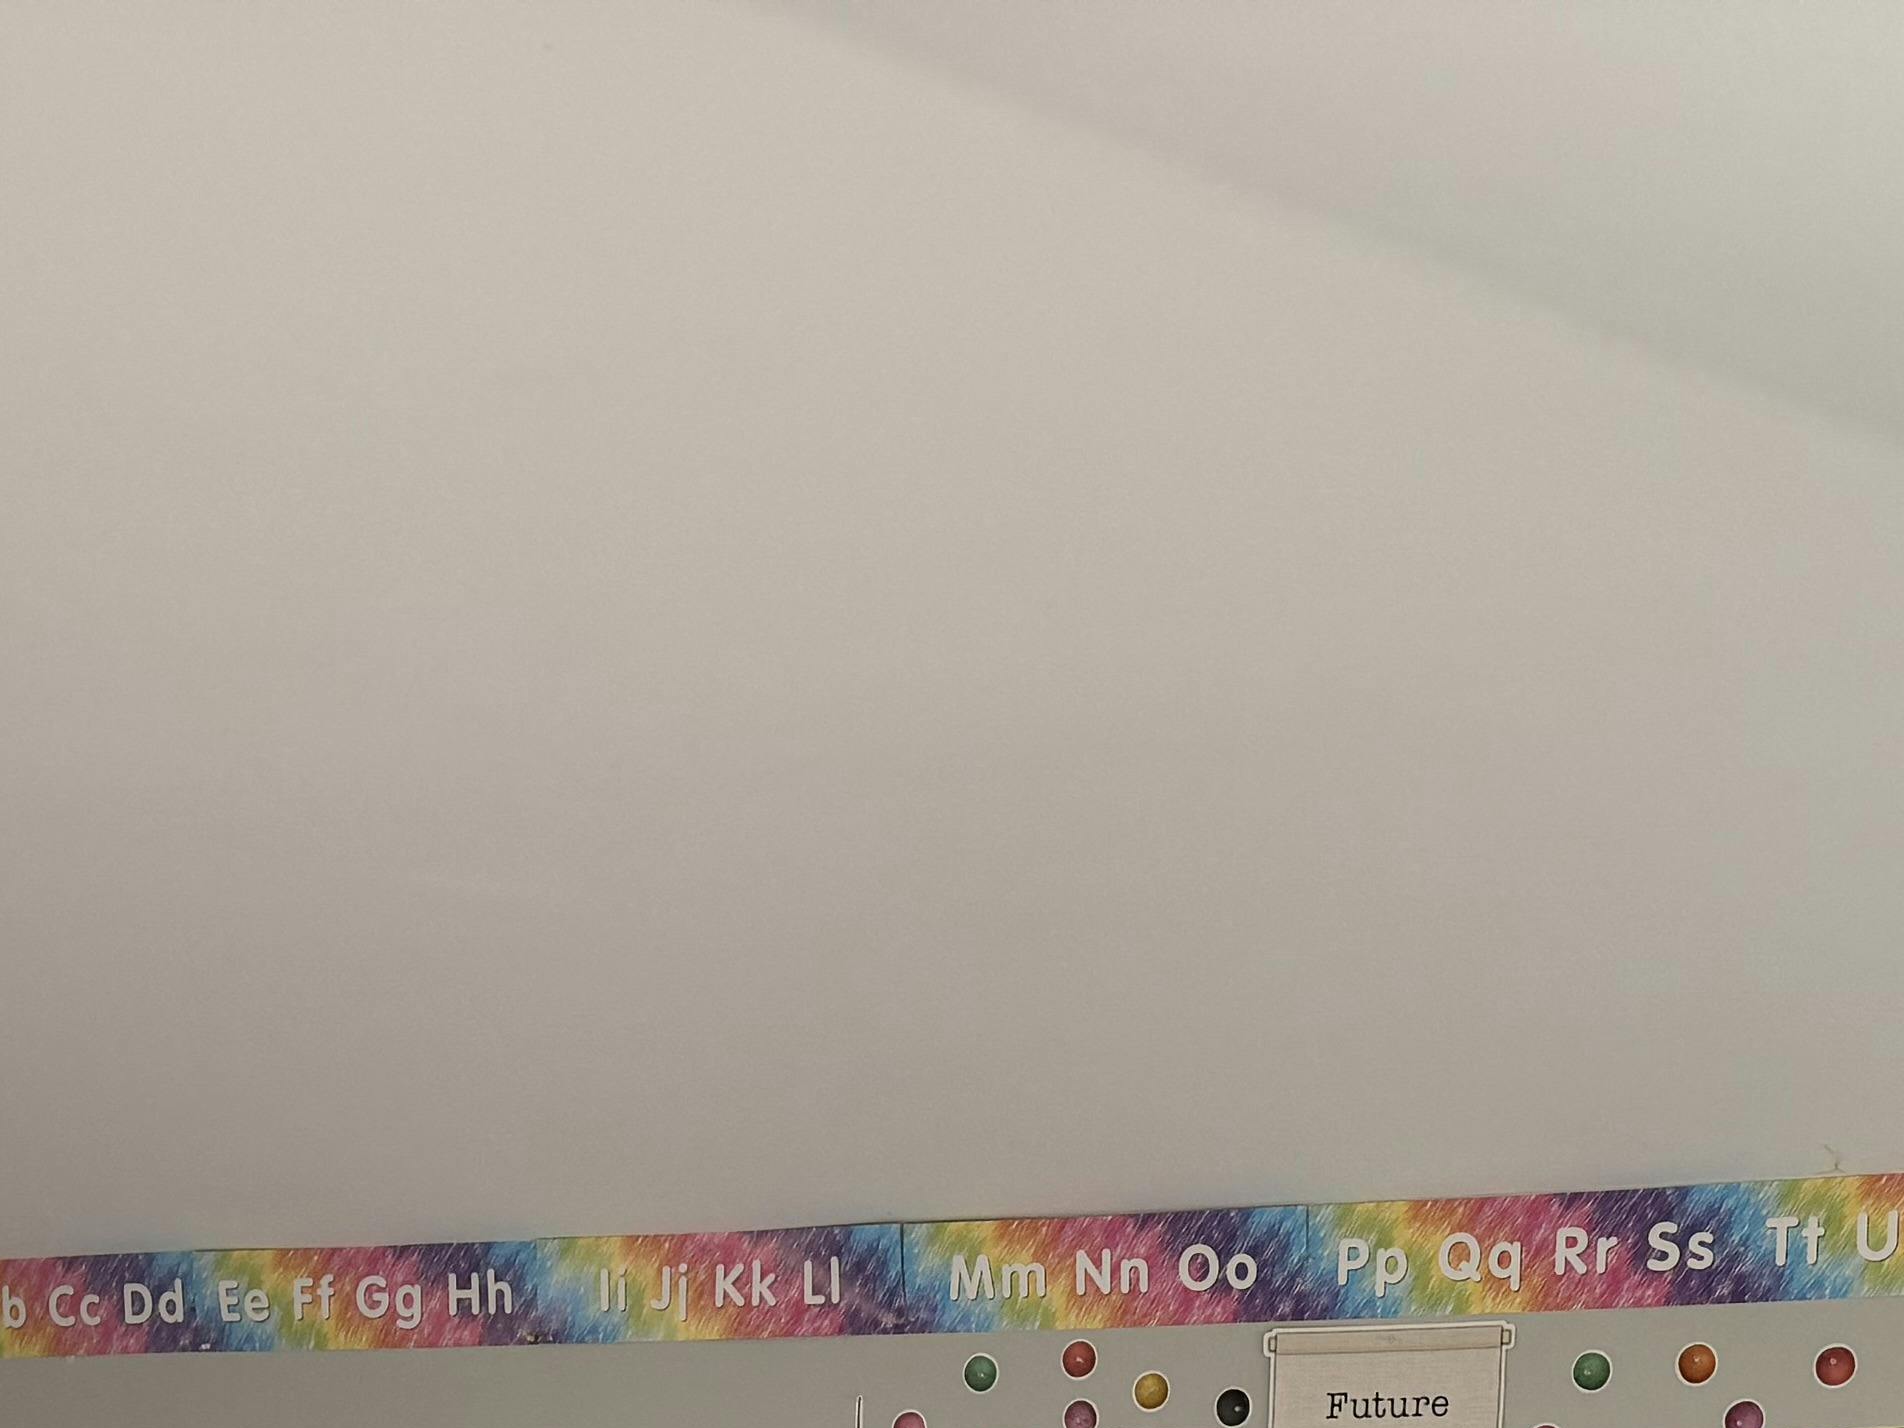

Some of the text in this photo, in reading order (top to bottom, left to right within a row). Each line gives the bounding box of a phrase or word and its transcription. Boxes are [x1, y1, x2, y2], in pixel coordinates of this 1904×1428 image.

[48, 1283, 102, 1326] Cc
[122, 1278, 184, 1324] Dd
[218, 1279, 270, 1322] Ee
[295, 1272, 336, 1321] Ff
[355, 1273, 423, 1330] Gg
[446, 1269, 513, 1315] Hh
[599, 1267, 627, 1312] Ii
[648, 1262, 688, 1322] Jj
[714, 1258, 776, 1309] Kk
[803, 1255, 841, 1306] Ll
[949, 1253, 1046, 1301] Mm
[1074, 1249, 1149, 1296] Nn
[1178, 1243, 1258, 1292] Oo
[1337, 1237, 1408, 1296] Pp
[1437, 1231, 1521, 1291] Qq
[1554, 1226, 1618, 1276] Rr
[1646, 1221, 1715, 1273] Ss
[1765, 1212, 1825, 1267] Tt
[1326, 1392, 1449, 1419] Future
